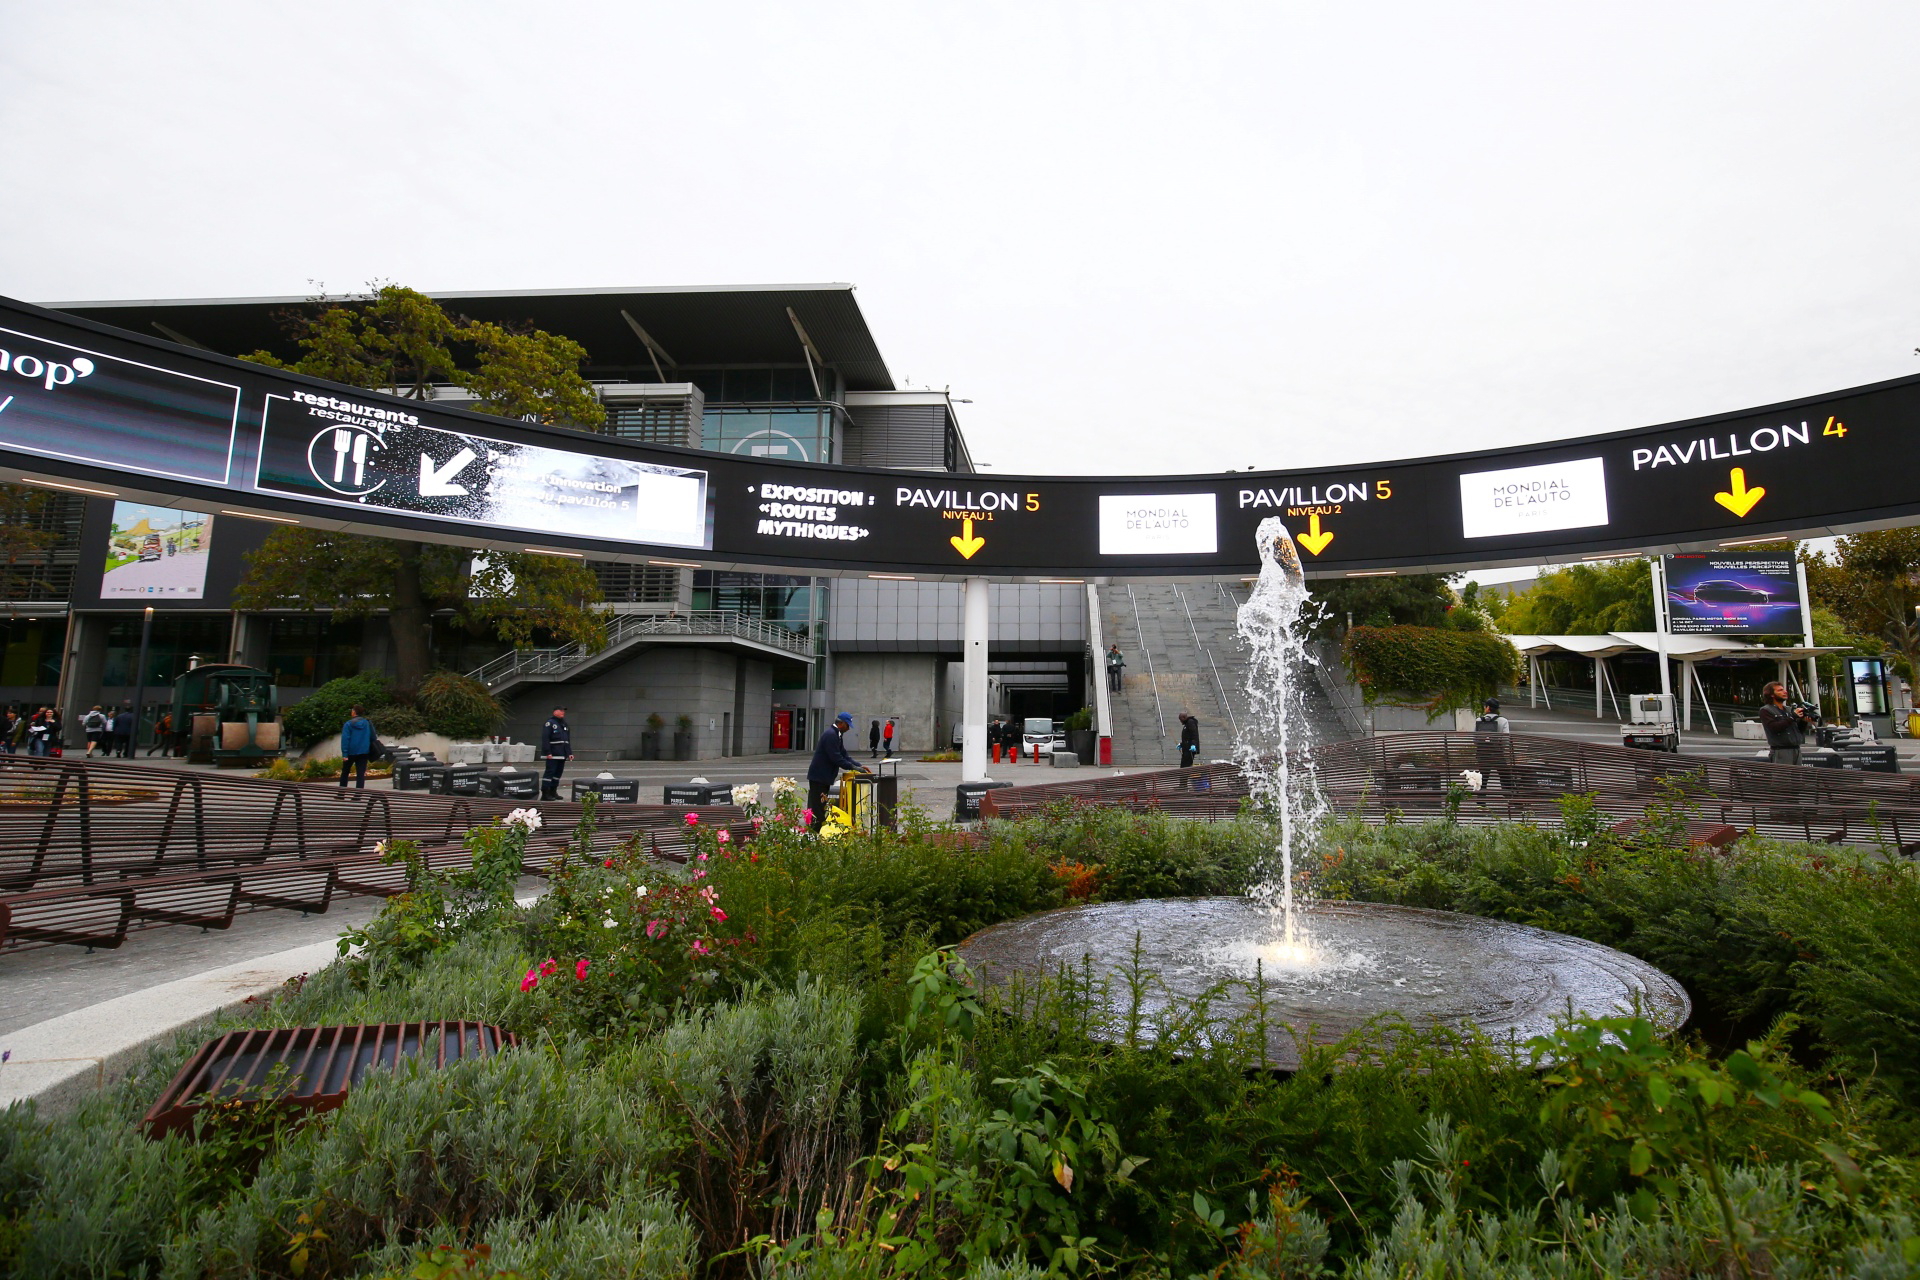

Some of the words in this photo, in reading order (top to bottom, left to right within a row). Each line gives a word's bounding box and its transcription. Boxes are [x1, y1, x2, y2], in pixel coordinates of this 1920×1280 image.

[292, 390, 419, 426] restaurants
[308, 407, 402, 433] restaurants
[1632, 420, 1810, 471] PAVILLON
[1822, 416, 1848, 439] 4
[487, 450, 529, 468] Paul
[760, 484, 864, 506] EXPOSITION
[1239, 482, 1368, 508] PAVILLON
[1375, 480, 1392, 500] 5
[1493, 479, 1569, 496] MONDIAL
[557, 493, 617, 510] pavillon
[620, 501, 630, 511] 5
[896, 487, 1018, 511] PAVILLON
[1025, 493, 1040, 512] 5
[1494, 497, 1513, 508] DE
[1516, 490, 1571, 506] L'AUTO
[942, 510, 985, 521] NIVEAU
[987, 512, 994, 521] 1
[1126, 509, 1188, 518] MONDIAL
[1287, 506, 1332, 517] NIVEAU
[1334, 504, 1342, 515] 2
[1518, 510, 1548, 518] PARIS
[757, 520, 870, 541] MYTHIQUES»
[1126, 520, 1142, 529] DE
[1145, 519, 1189, 529] L'AUTO
